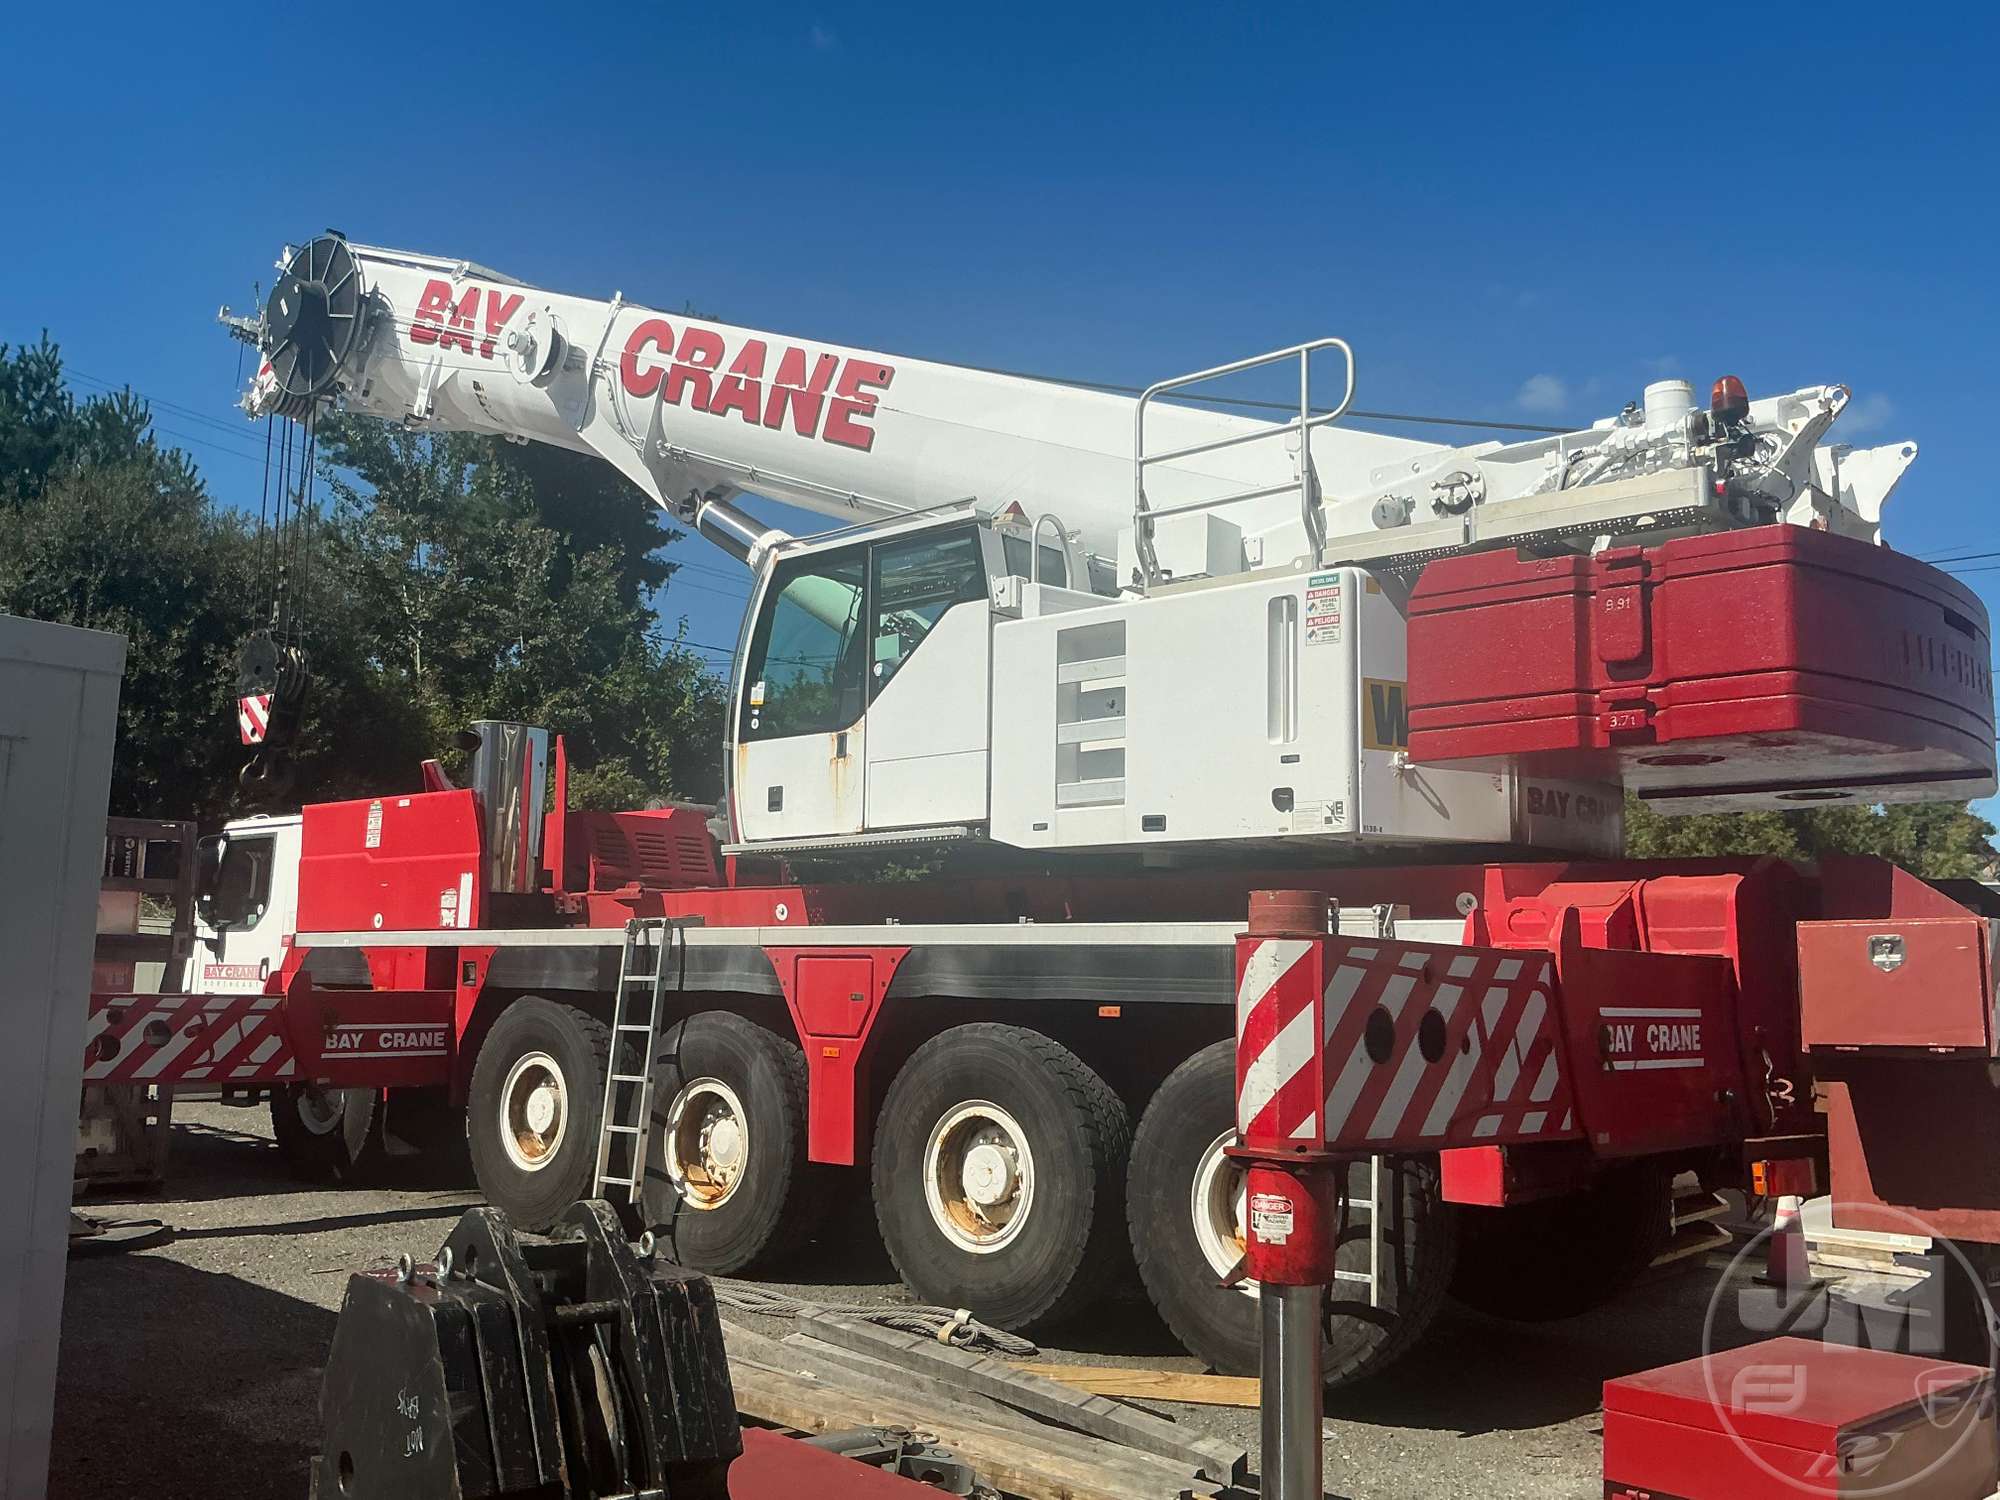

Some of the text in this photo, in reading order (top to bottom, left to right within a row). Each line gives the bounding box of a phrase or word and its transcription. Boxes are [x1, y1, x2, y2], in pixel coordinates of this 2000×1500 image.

[410, 280, 895, 452] BAY CRANE
[1314, 588, 1338, 598] DANGER
[1314, 615, 1339, 625] PELIGRO
[1527, 786, 1570, 819] BAY
[204, 966, 224, 977] BAY
[325, 1032, 445, 1049] BAY CRANE
[1646, 1024, 1701, 1053] CRANE
[1253, 1200, 1284, 1211] DANGER
